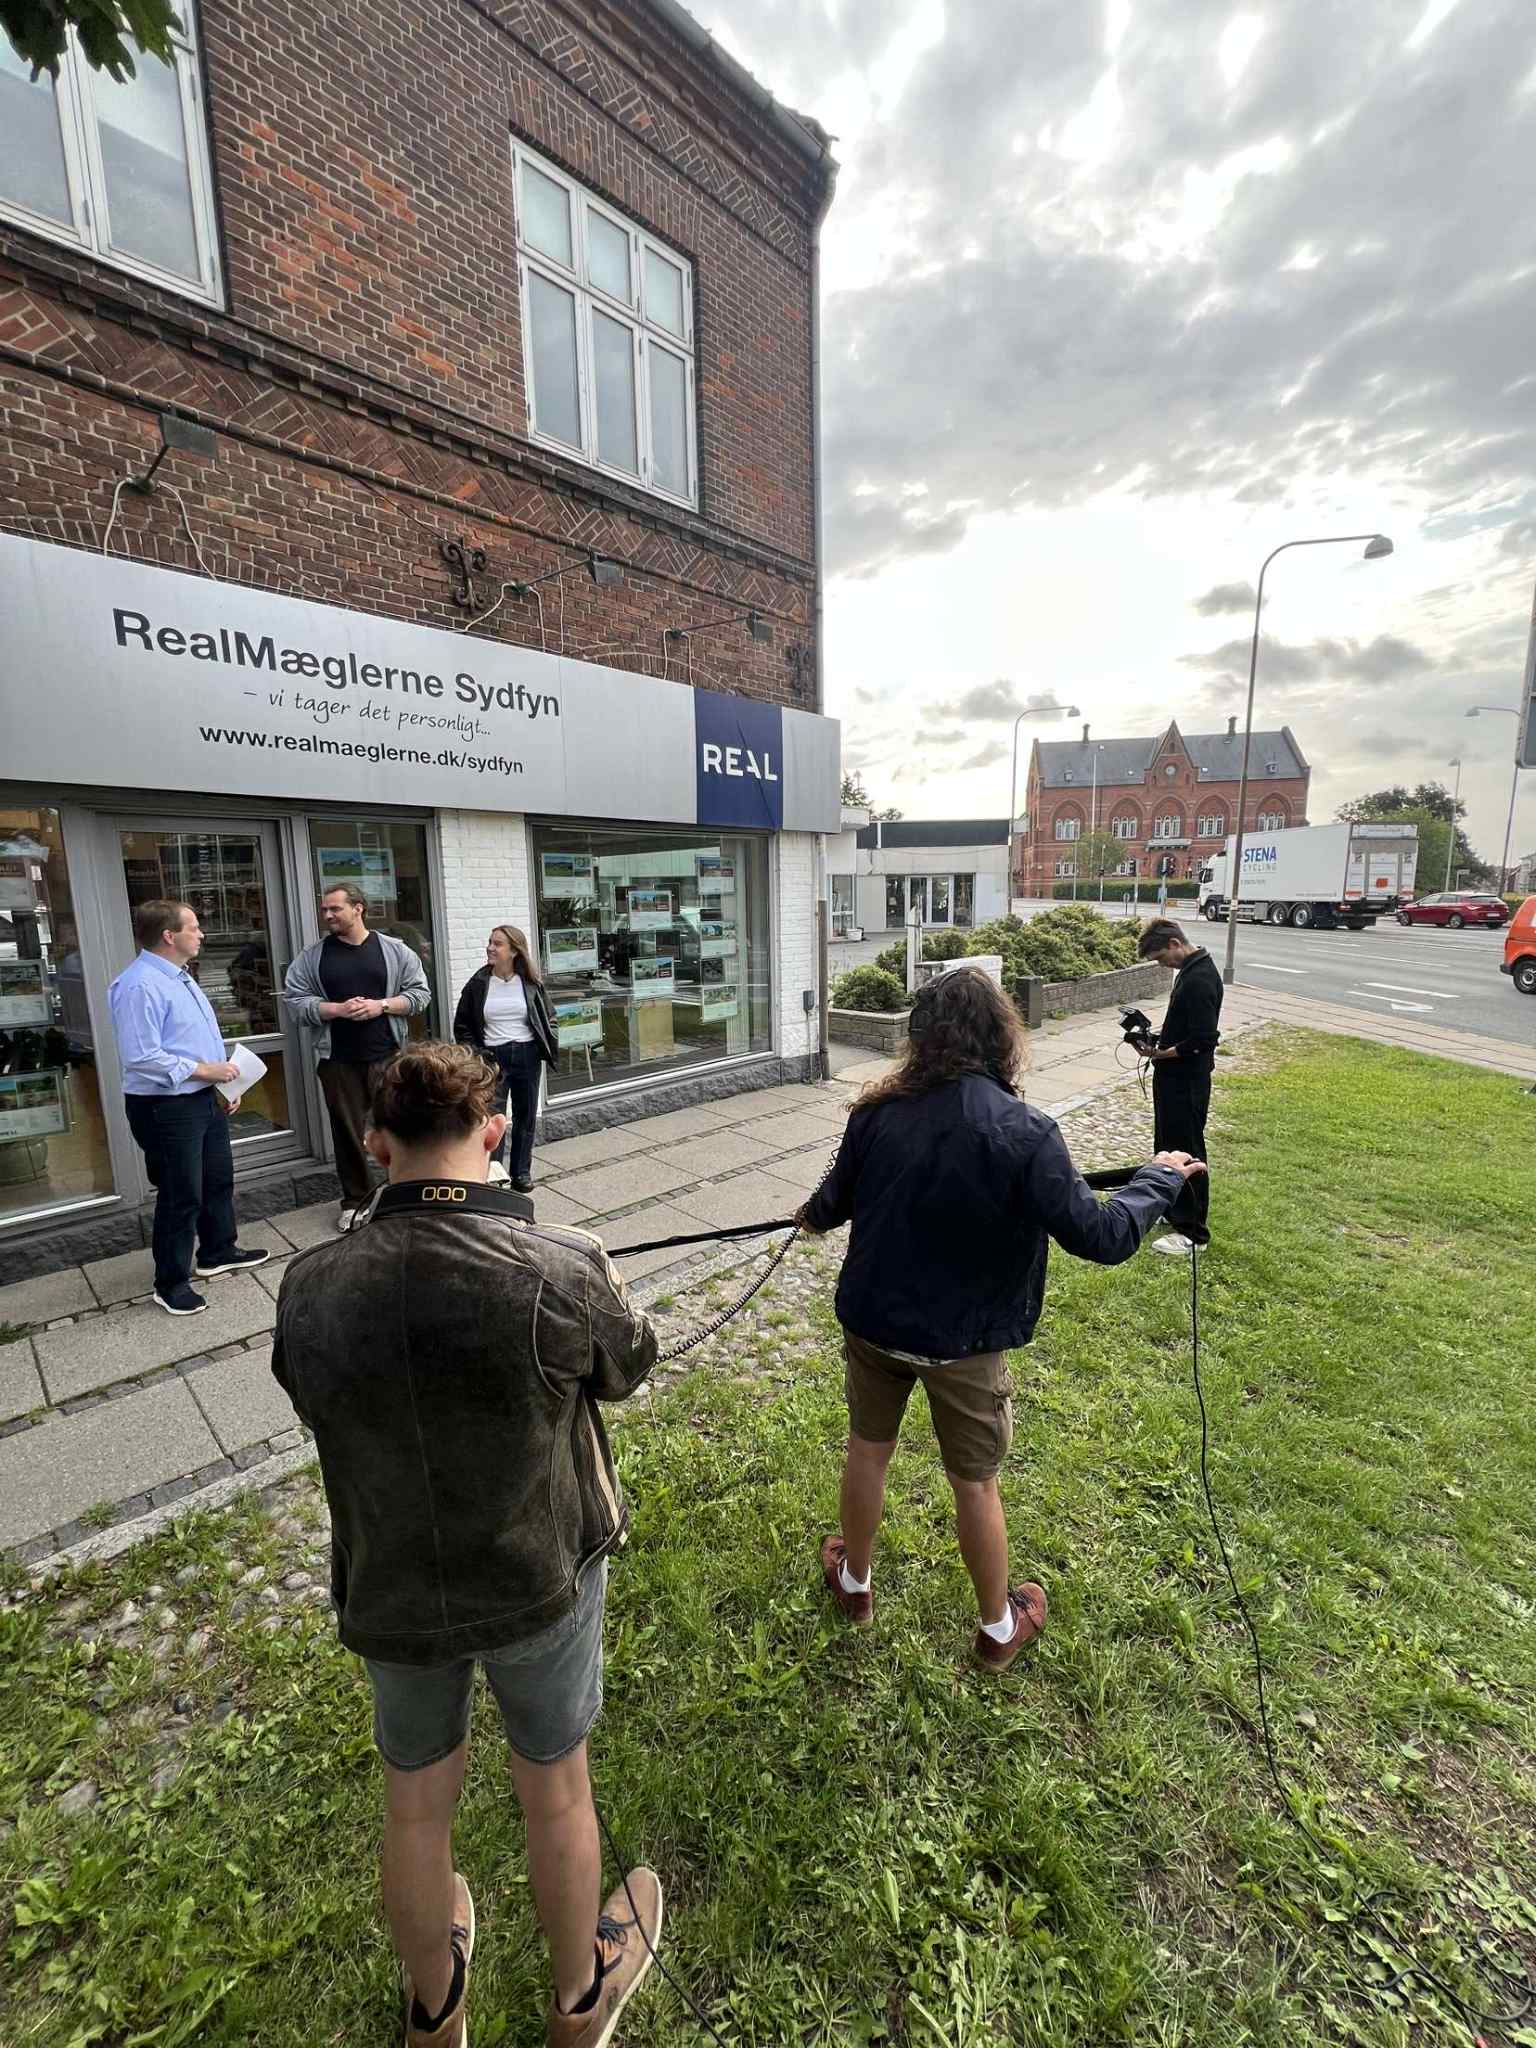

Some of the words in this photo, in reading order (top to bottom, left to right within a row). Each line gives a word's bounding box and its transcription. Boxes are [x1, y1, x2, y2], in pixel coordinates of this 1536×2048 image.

[112, 607, 444, 698] RealMæglerne
[455, 672, 560, 719] Sydfyn
[269, 689, 284, 707] vi
[295, 693, 351, 724] tager
[359, 700, 390, 721] det
[200, 726, 523, 776] www.realmaeglerne.dk/sydfyn
[703, 743, 778, 781] REAL
[1239, 863, 1277, 873] CYCLING
[1244, 847, 1277, 863] STENA
